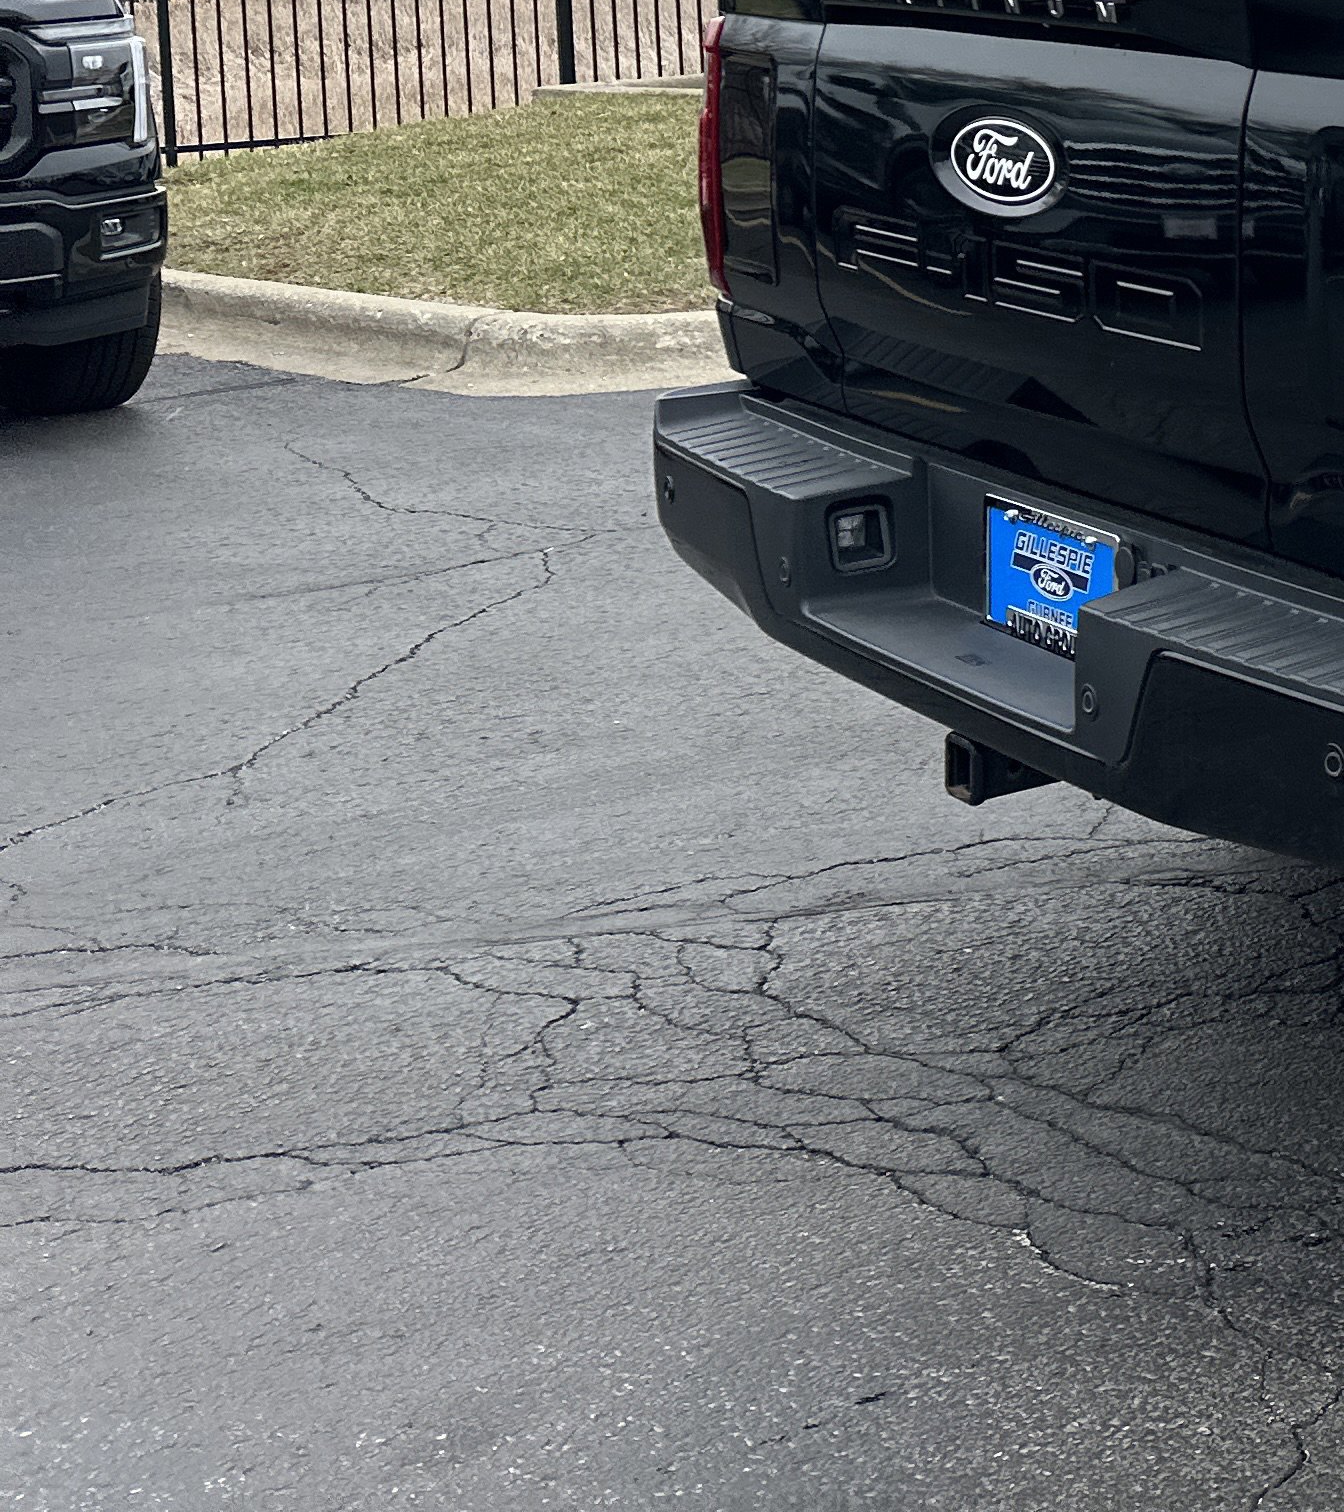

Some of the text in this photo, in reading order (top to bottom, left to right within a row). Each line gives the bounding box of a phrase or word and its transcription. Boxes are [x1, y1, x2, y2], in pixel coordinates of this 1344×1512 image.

[966, 128, 1034, 190] Ford
[1014, 530, 1095, 574] GILLESPIE
[1037, 570, 1066, 596] Ford
